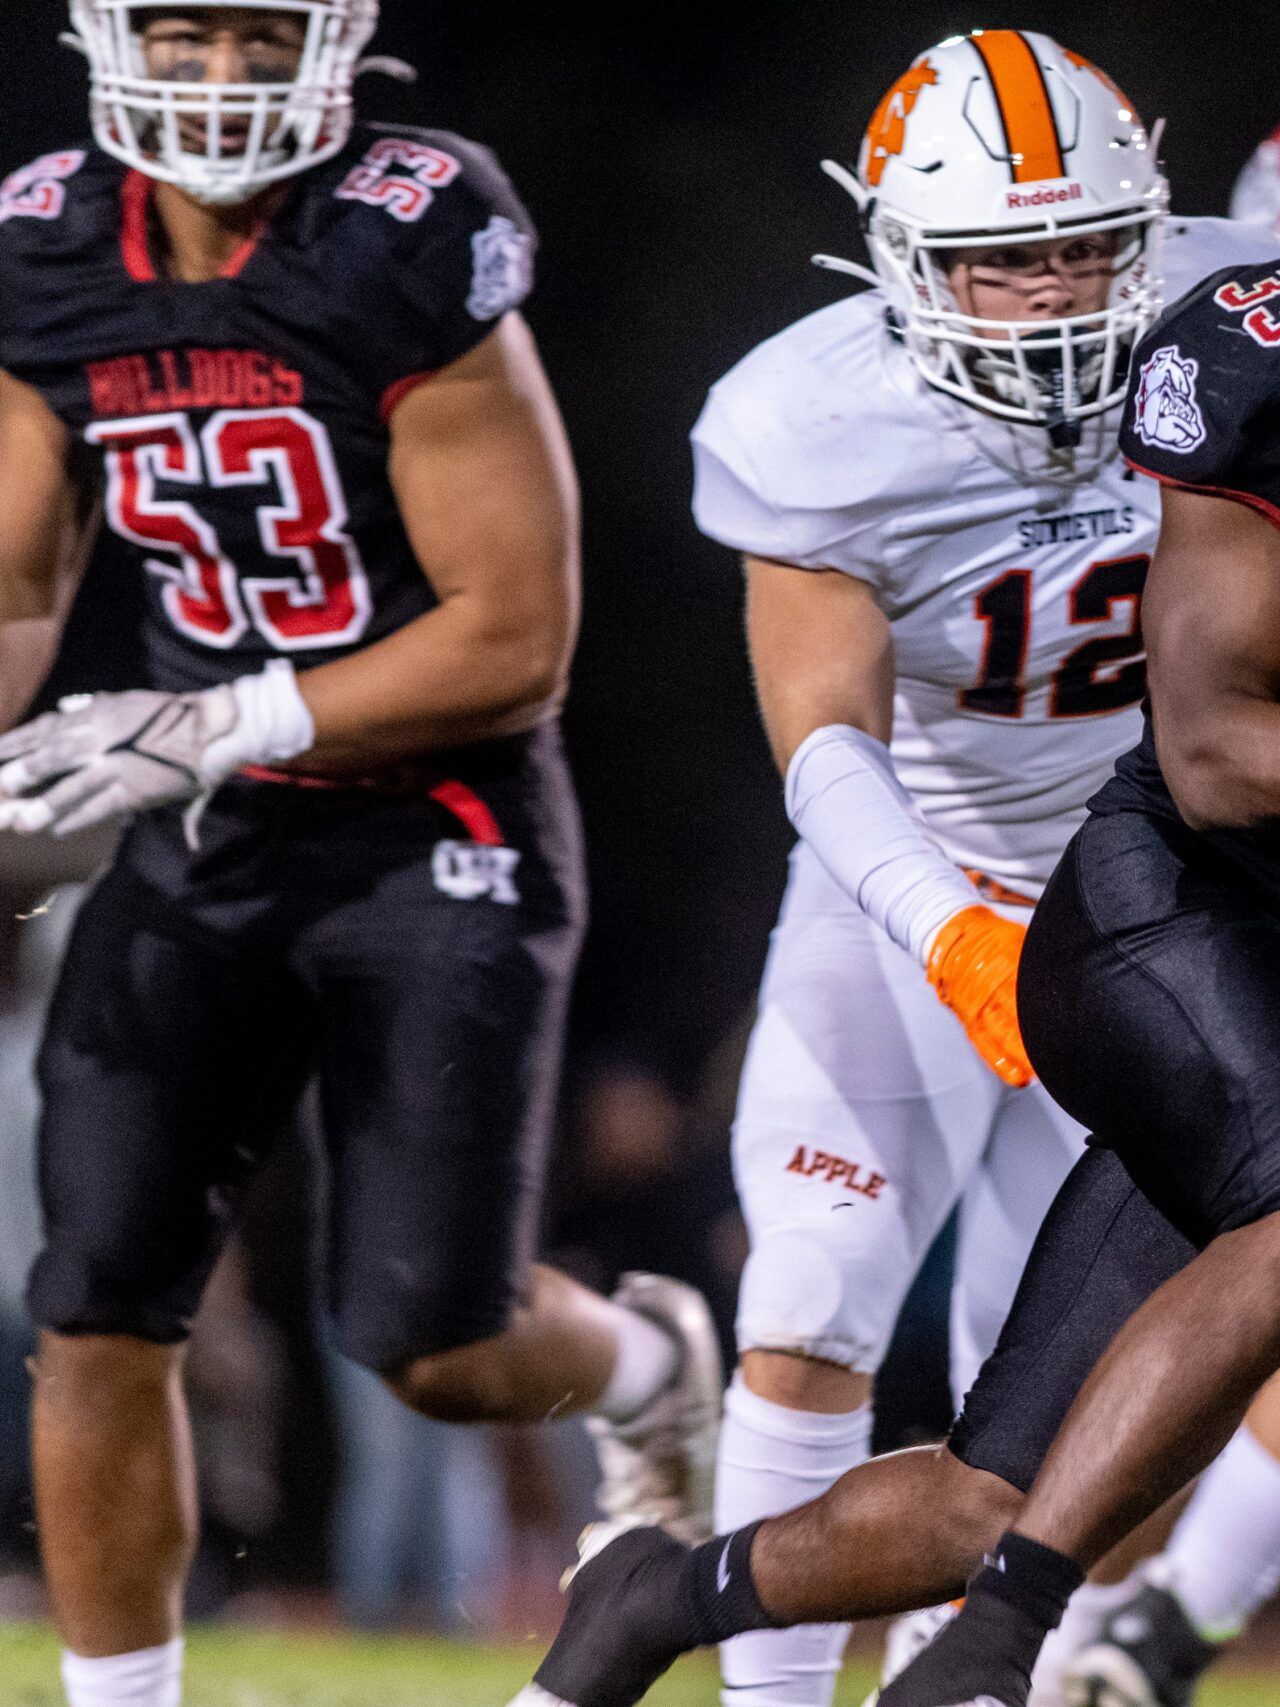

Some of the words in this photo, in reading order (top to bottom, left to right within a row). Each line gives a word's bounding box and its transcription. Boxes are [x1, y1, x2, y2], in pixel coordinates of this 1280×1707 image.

[334, 139, 461, 222] 53
[1007, 183, 1083, 208] Riddell
[85, 407, 373, 650] 53
[958, 552, 1152, 718] 12
[785, 1144, 886, 1200] APPLE
